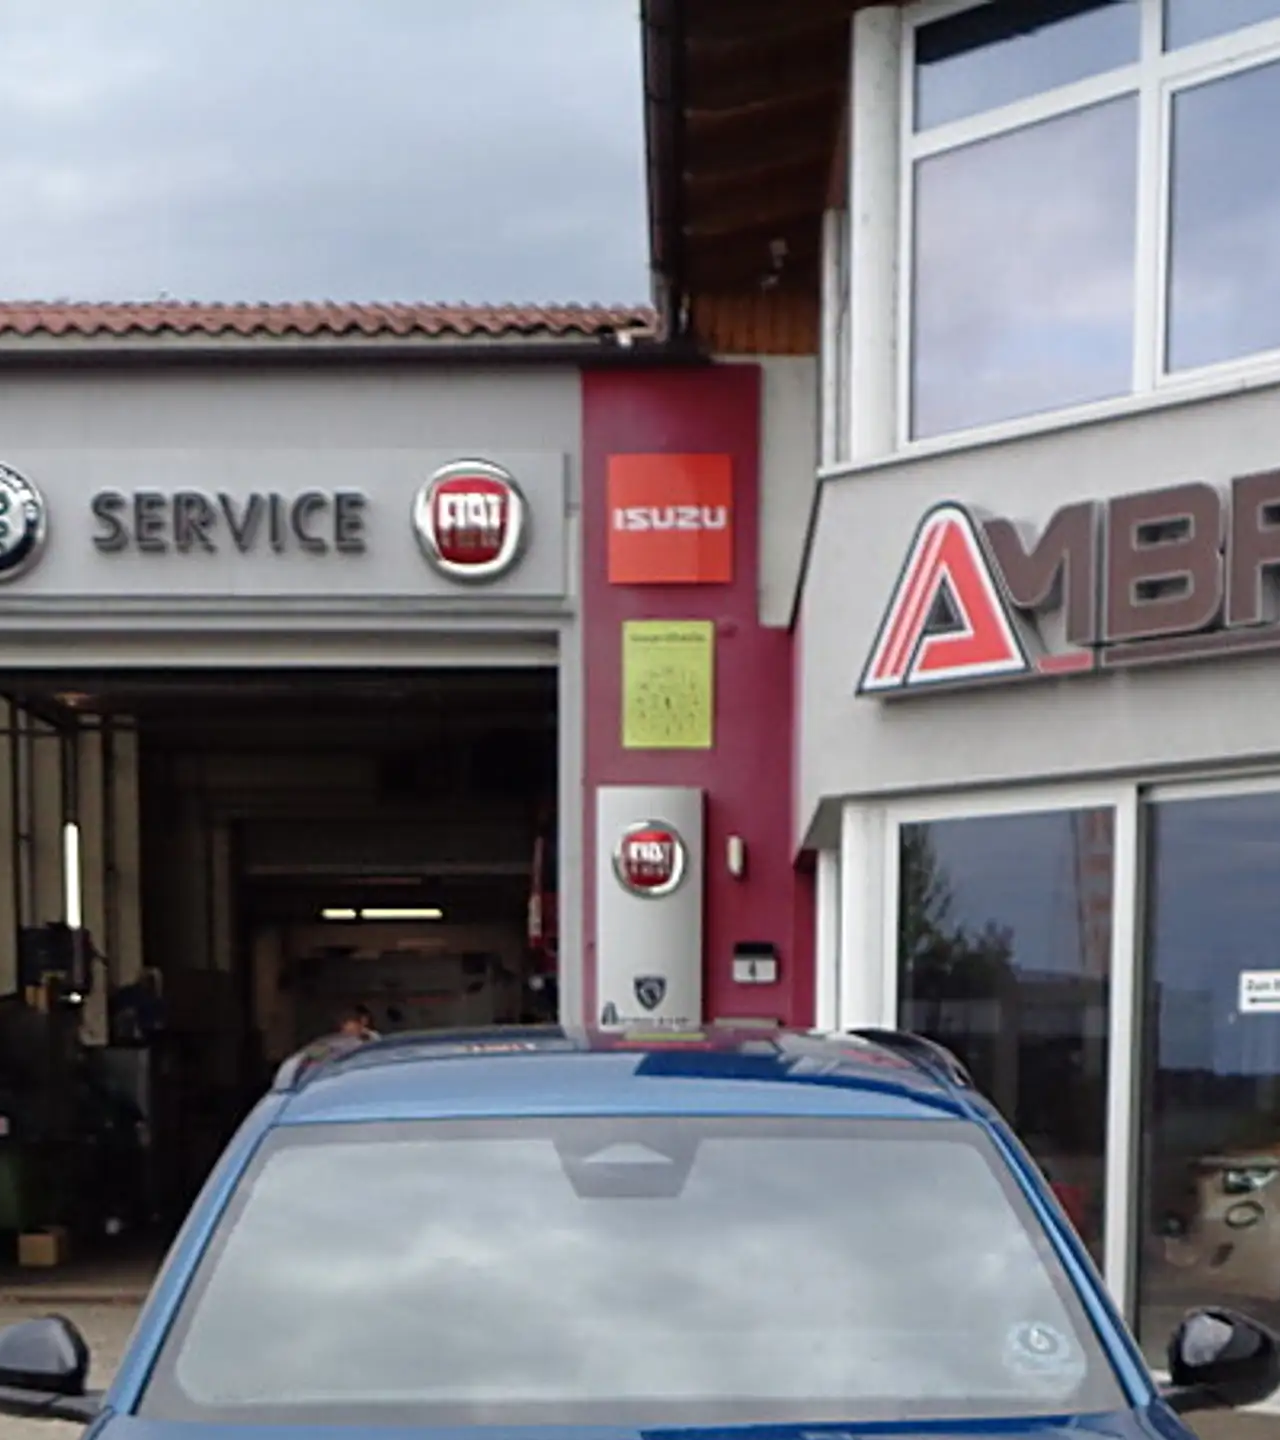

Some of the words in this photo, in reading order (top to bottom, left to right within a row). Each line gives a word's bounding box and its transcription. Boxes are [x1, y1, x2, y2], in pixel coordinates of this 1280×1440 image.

[91, 491, 368, 555] SERVICE
[438, 492, 500, 530] FIAT
[613, 506, 726, 531] ISUZU
